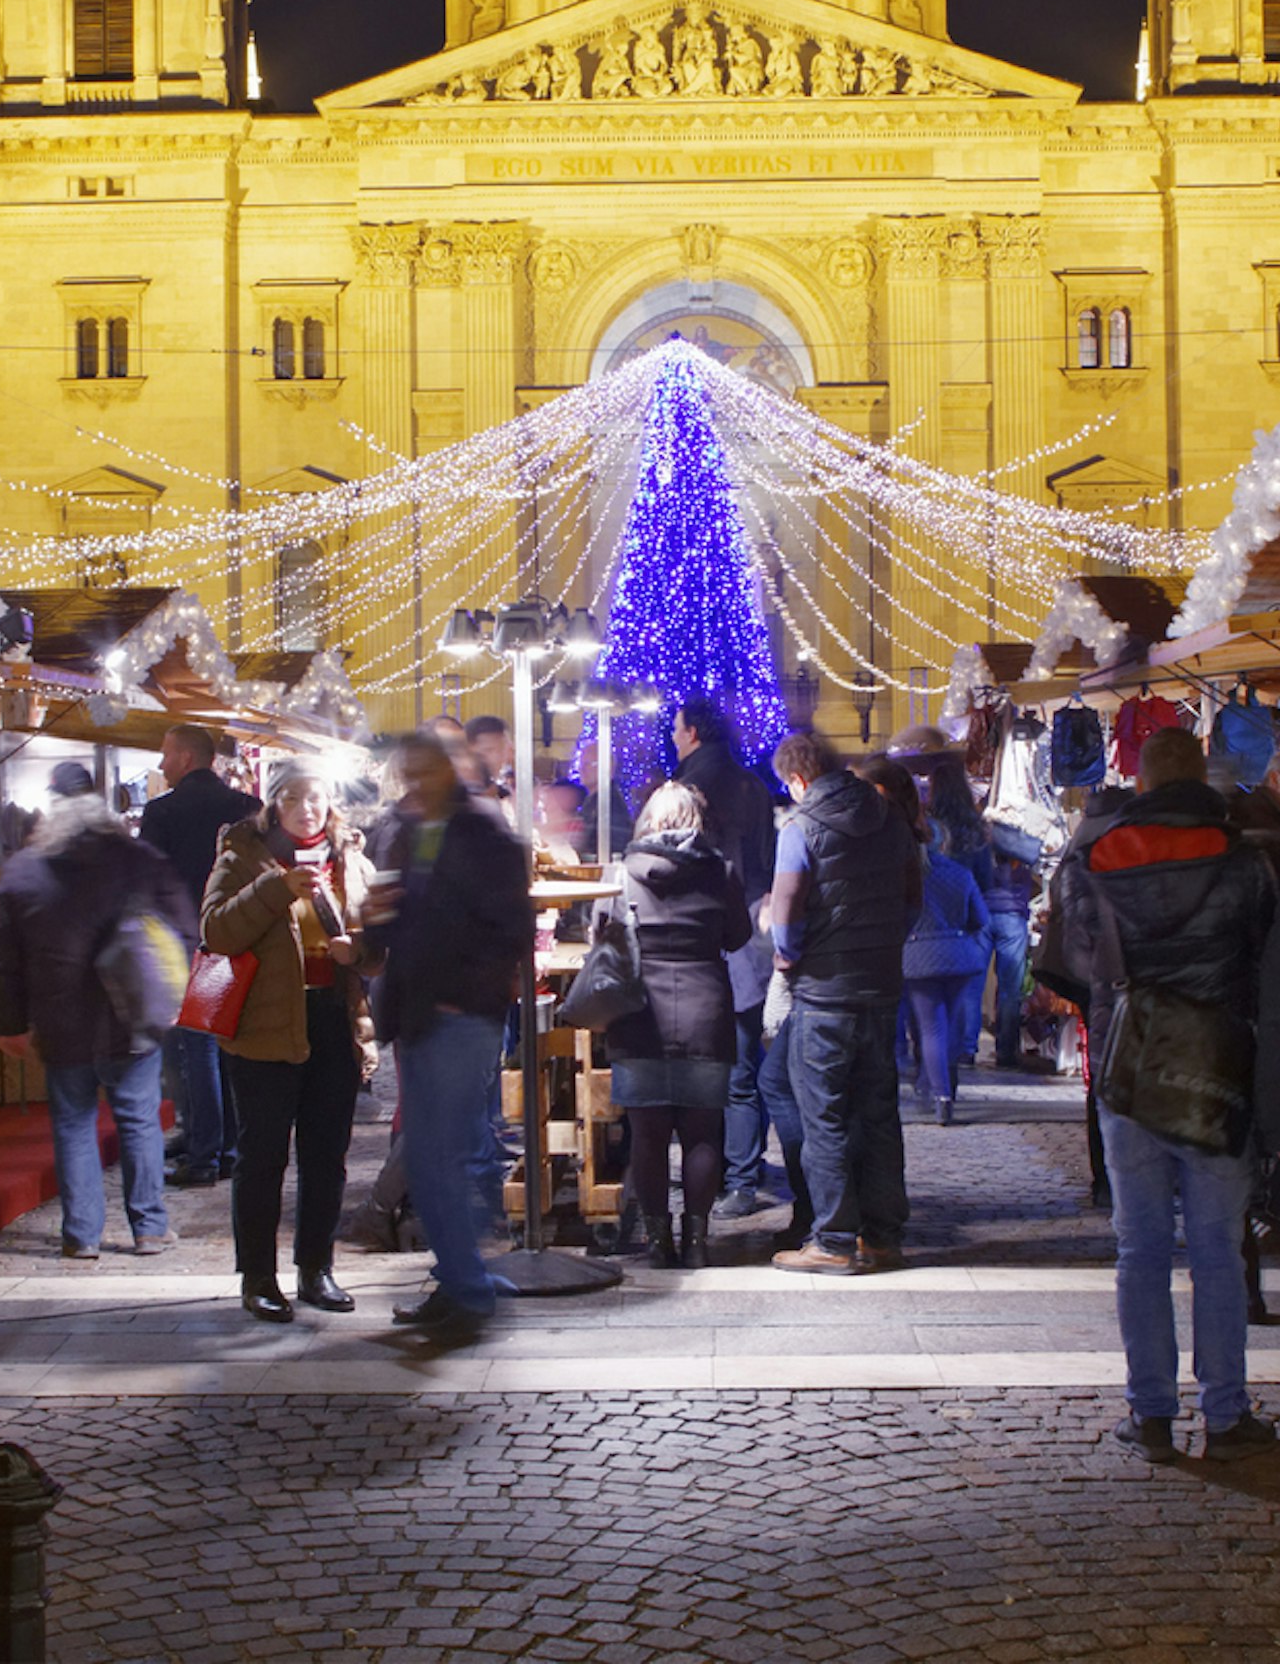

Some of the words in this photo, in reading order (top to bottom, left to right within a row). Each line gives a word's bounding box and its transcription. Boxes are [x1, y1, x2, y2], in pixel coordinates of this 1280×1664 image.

[492, 156, 543, 177] EGO
[560, 155, 614, 176] SUM
[634, 155, 676, 175] VIA
[691, 154, 792, 174] VERITAS
[808, 154, 838, 173] ET
[851, 152, 906, 172] VITA
